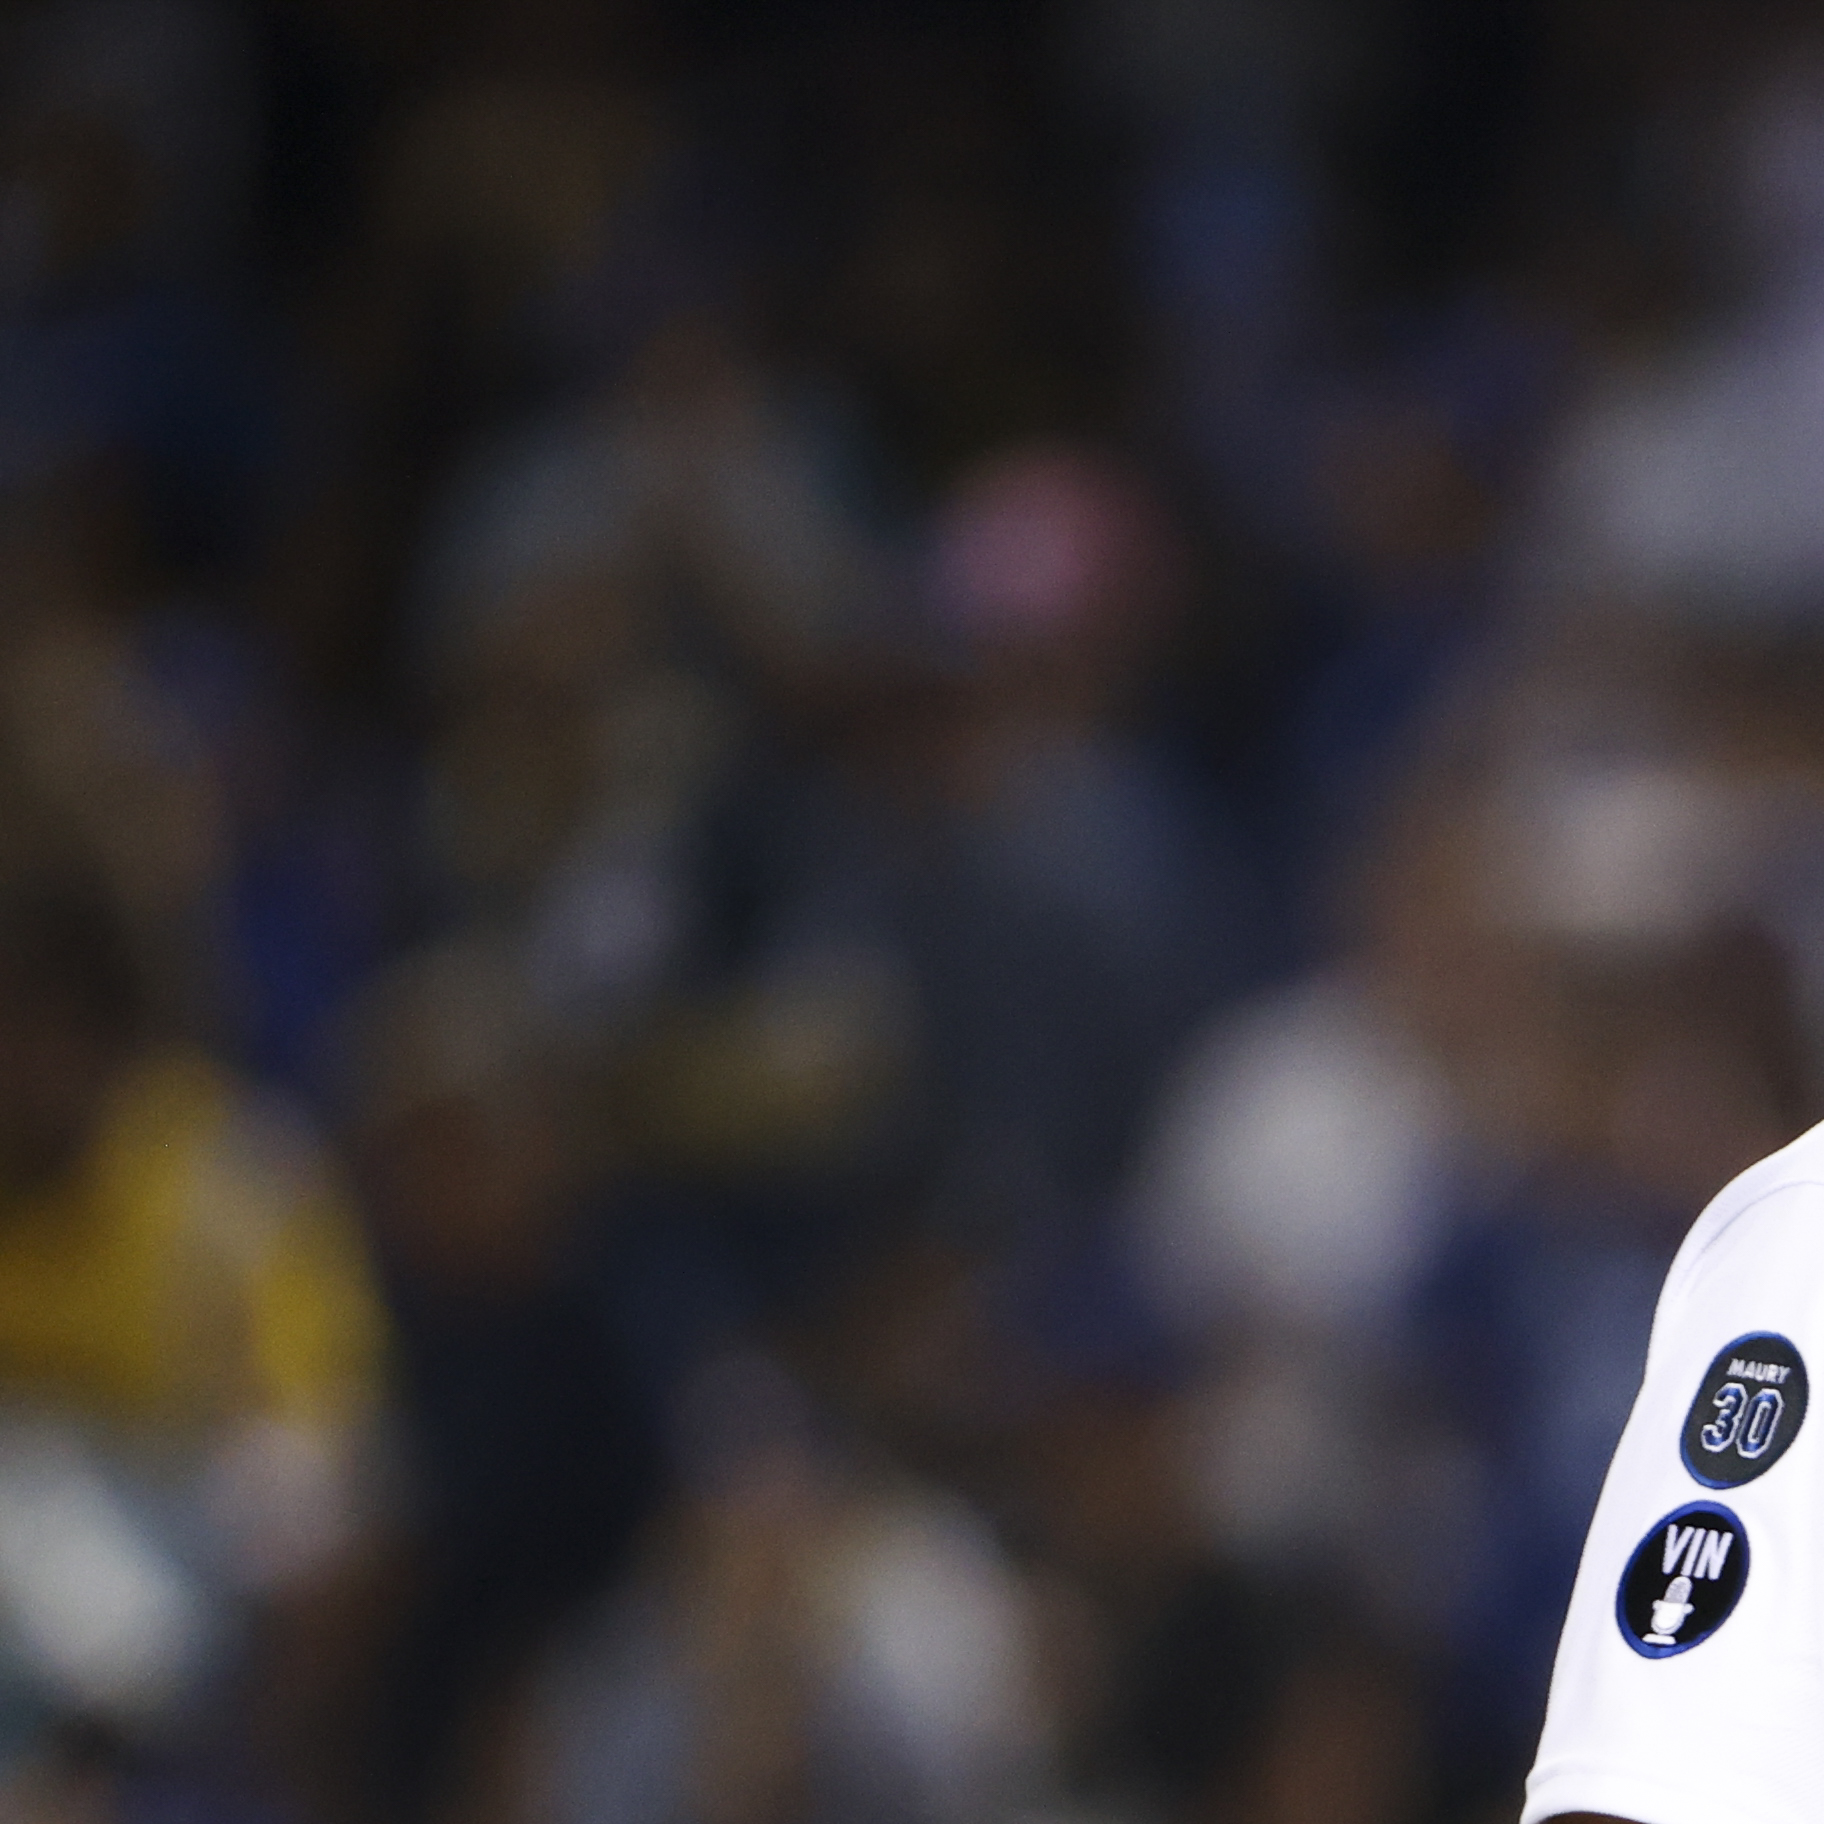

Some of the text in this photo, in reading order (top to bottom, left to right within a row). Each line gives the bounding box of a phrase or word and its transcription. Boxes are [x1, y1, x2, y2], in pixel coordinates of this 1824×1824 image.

[1726, 1358, 1791, 1384] MAURY
[1701, 1382, 1785, 1459] 30
[1661, 1523, 1734, 1581] VIN
